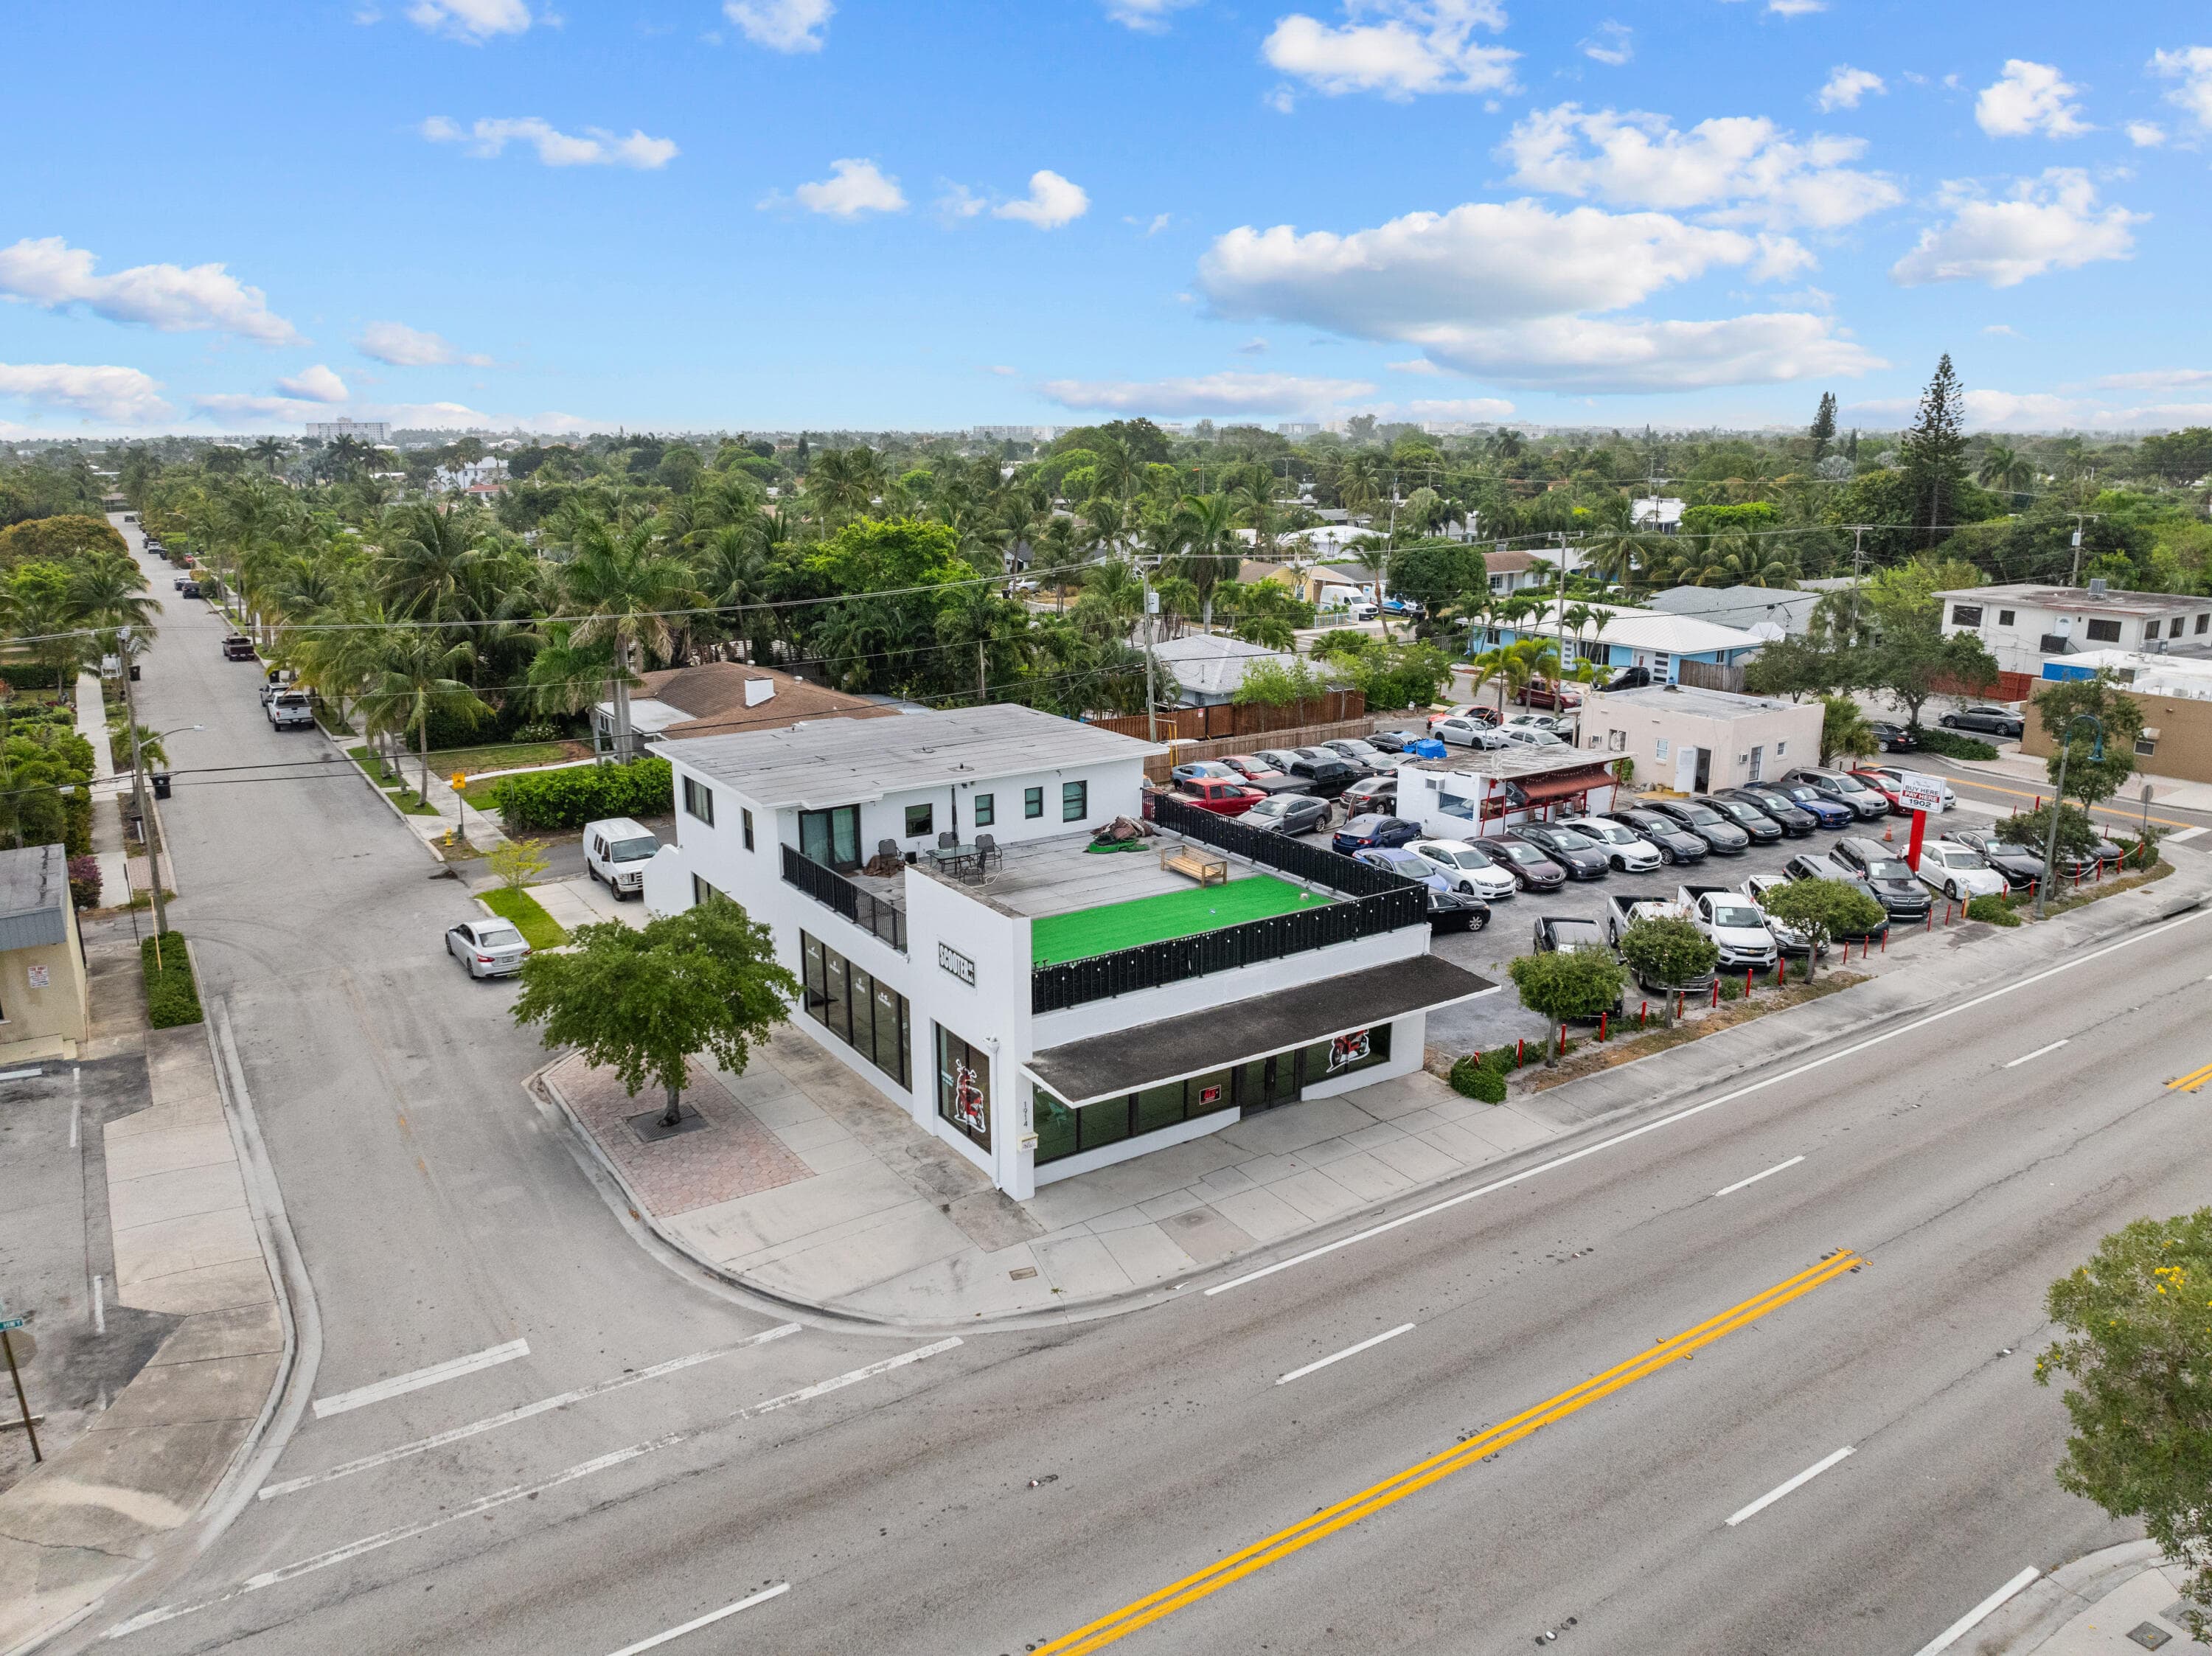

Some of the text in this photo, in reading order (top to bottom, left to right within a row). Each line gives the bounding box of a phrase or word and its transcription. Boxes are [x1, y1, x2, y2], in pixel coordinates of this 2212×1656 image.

[1919, 793, 1938, 802] HERE
[1909, 799, 1931, 808] 1902
[939, 944, 969, 981] SCOOTER
